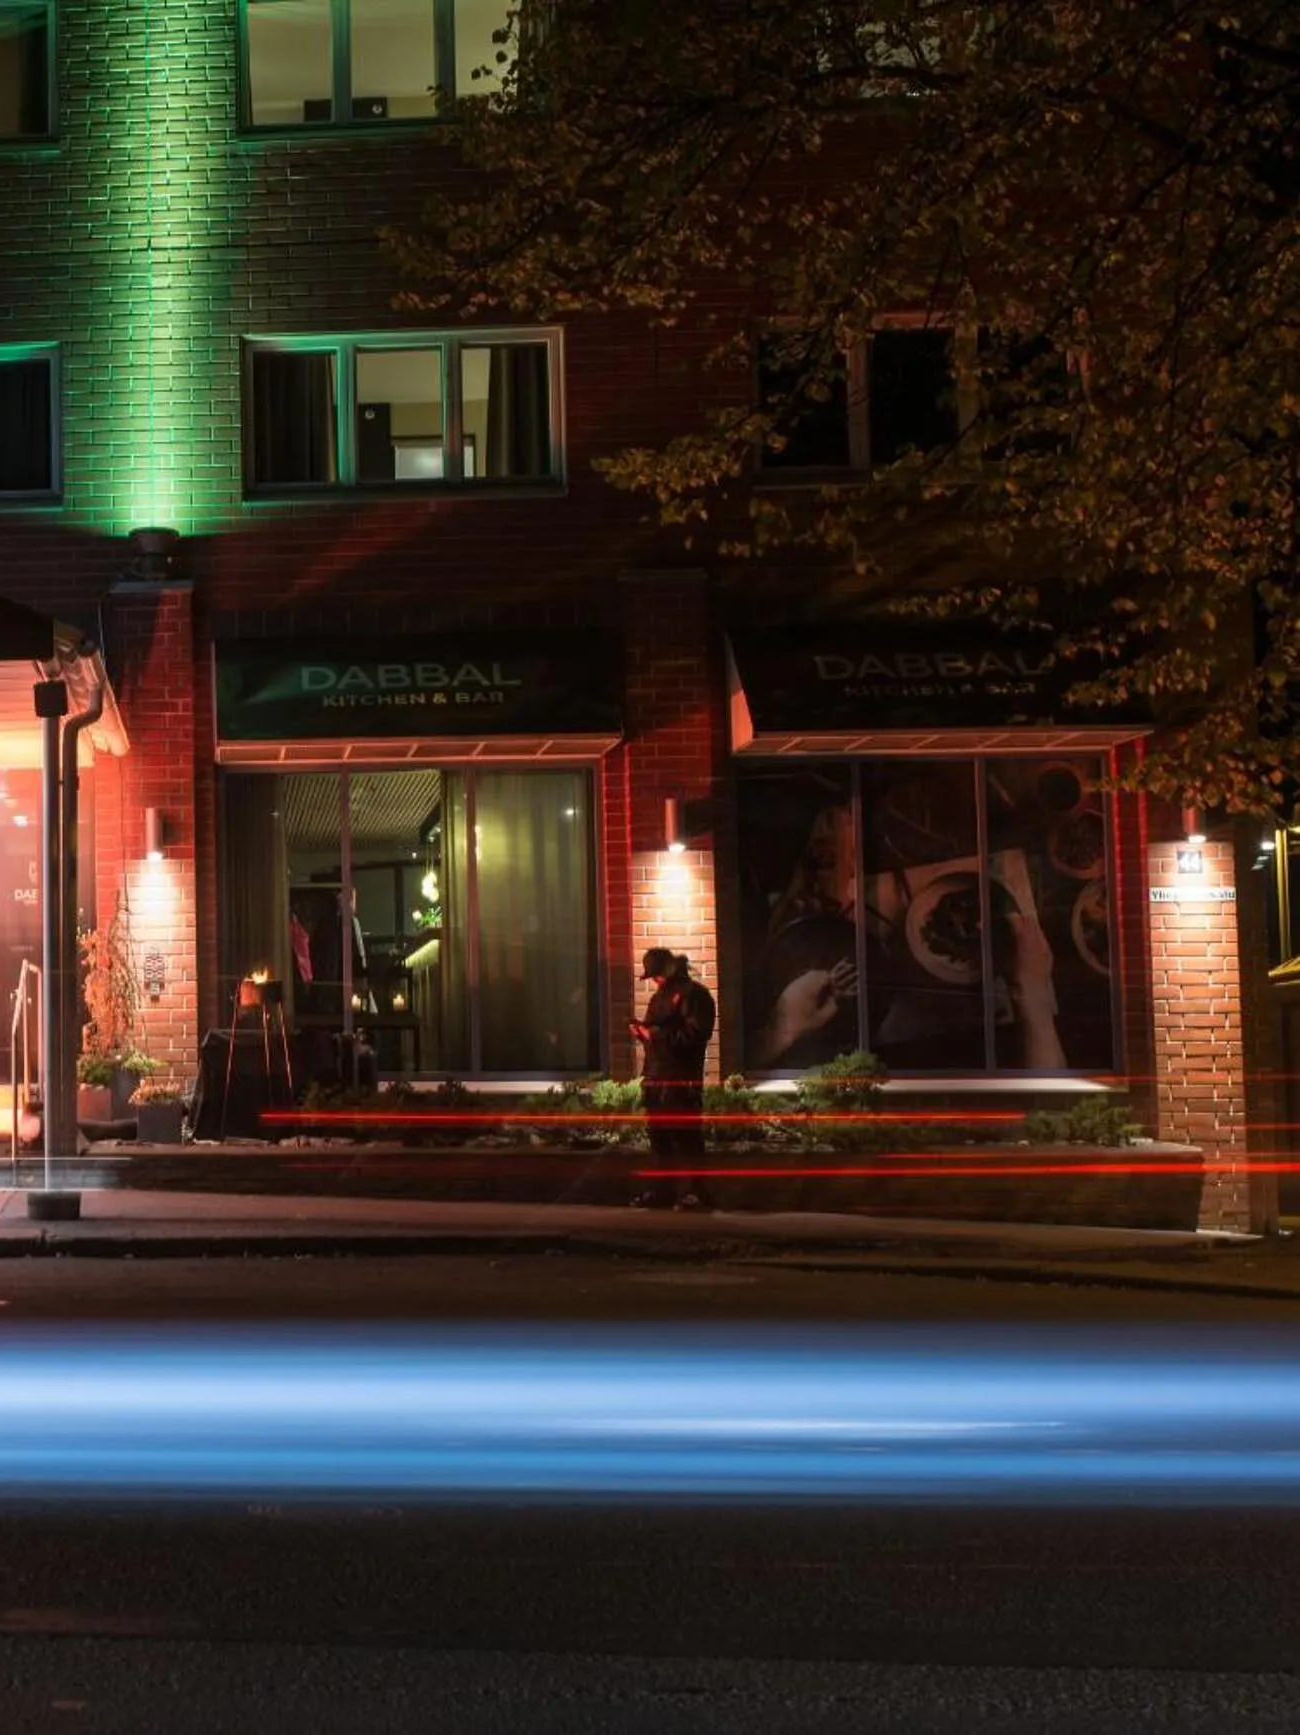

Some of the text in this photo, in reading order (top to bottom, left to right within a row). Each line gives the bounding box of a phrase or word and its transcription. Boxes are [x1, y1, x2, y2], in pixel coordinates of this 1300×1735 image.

[301, 662, 523, 690] DABBAL
[814, 650, 1050, 680] DABBAL
[322, 691, 504, 708] KITCHEN & BAR
